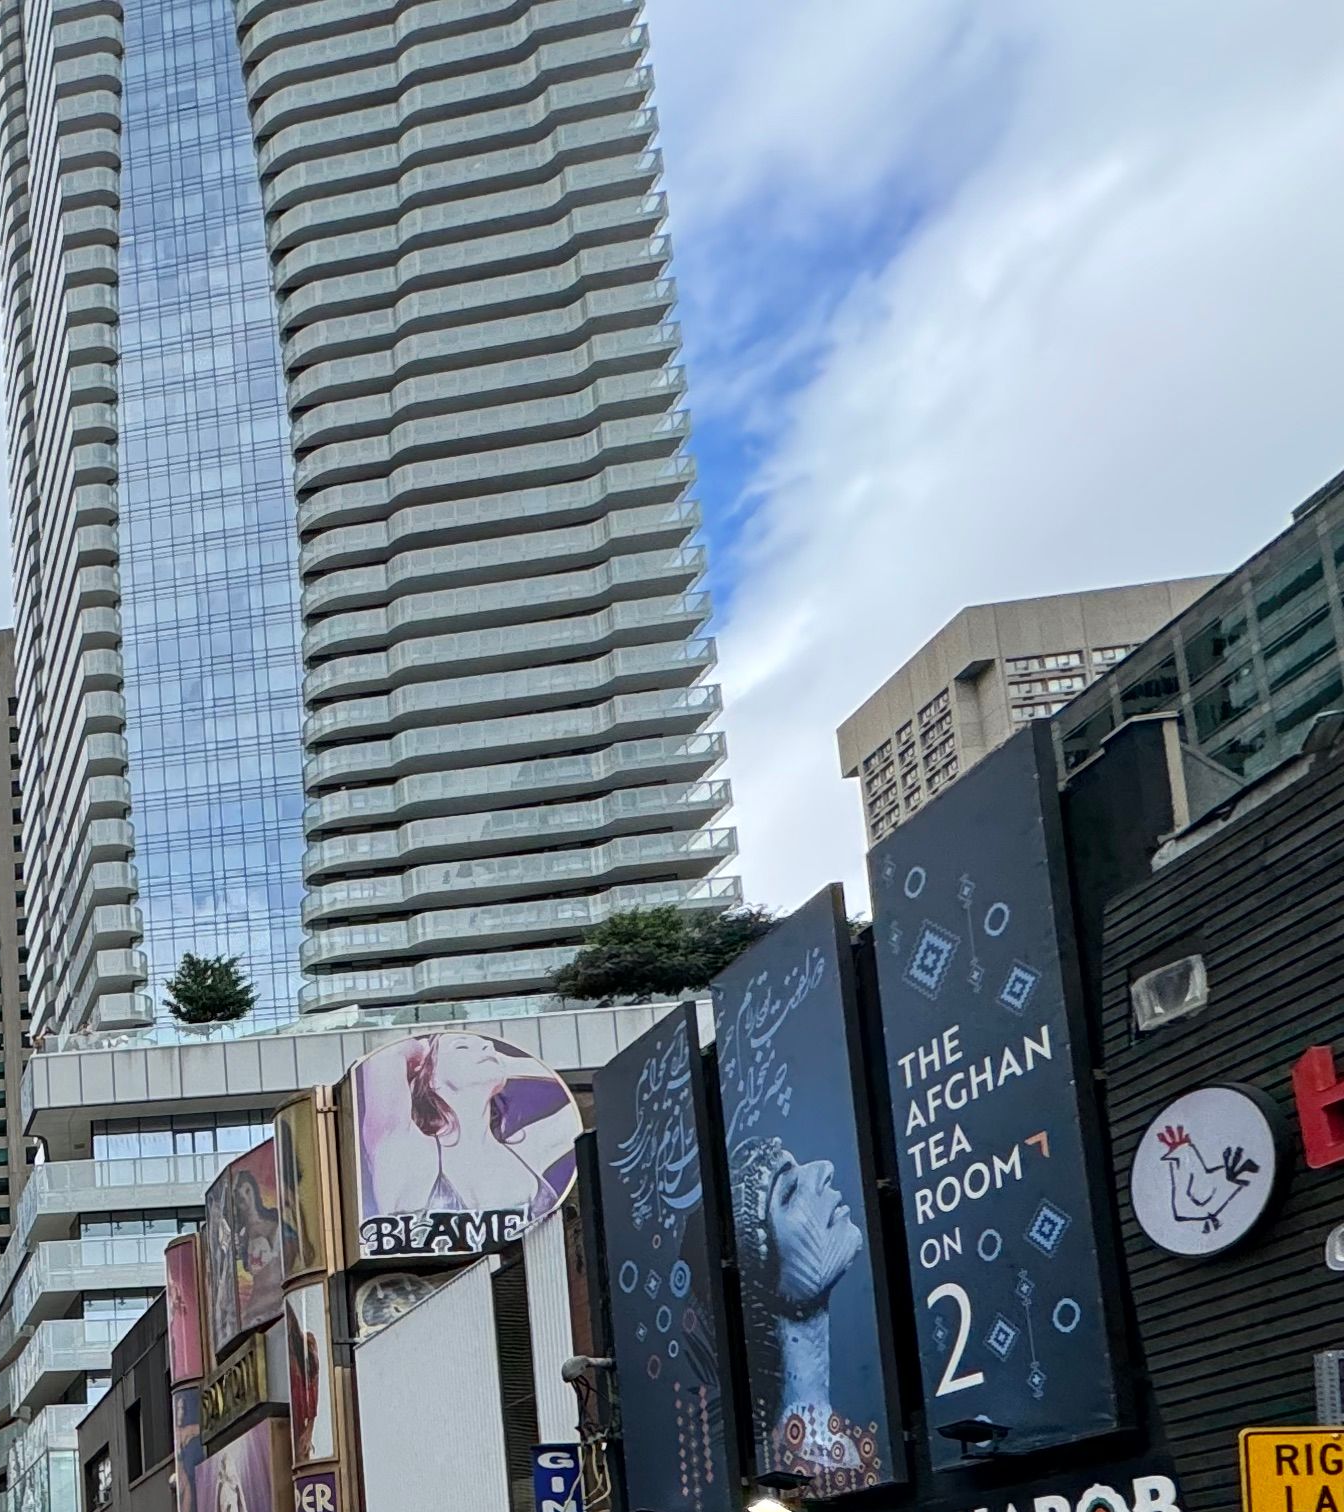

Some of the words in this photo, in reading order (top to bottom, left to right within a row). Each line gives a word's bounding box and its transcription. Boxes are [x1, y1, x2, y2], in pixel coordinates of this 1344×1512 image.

[897, 1024, 964, 1089] THE
[905, 1025, 1054, 1137] AFGHAN
[907, 1124, 972, 1178] TEA
[915, 1144, 1023, 1225] ROOM
[920, 1227, 962, 1269] ON
[927, 1283, 985, 1397] 2
